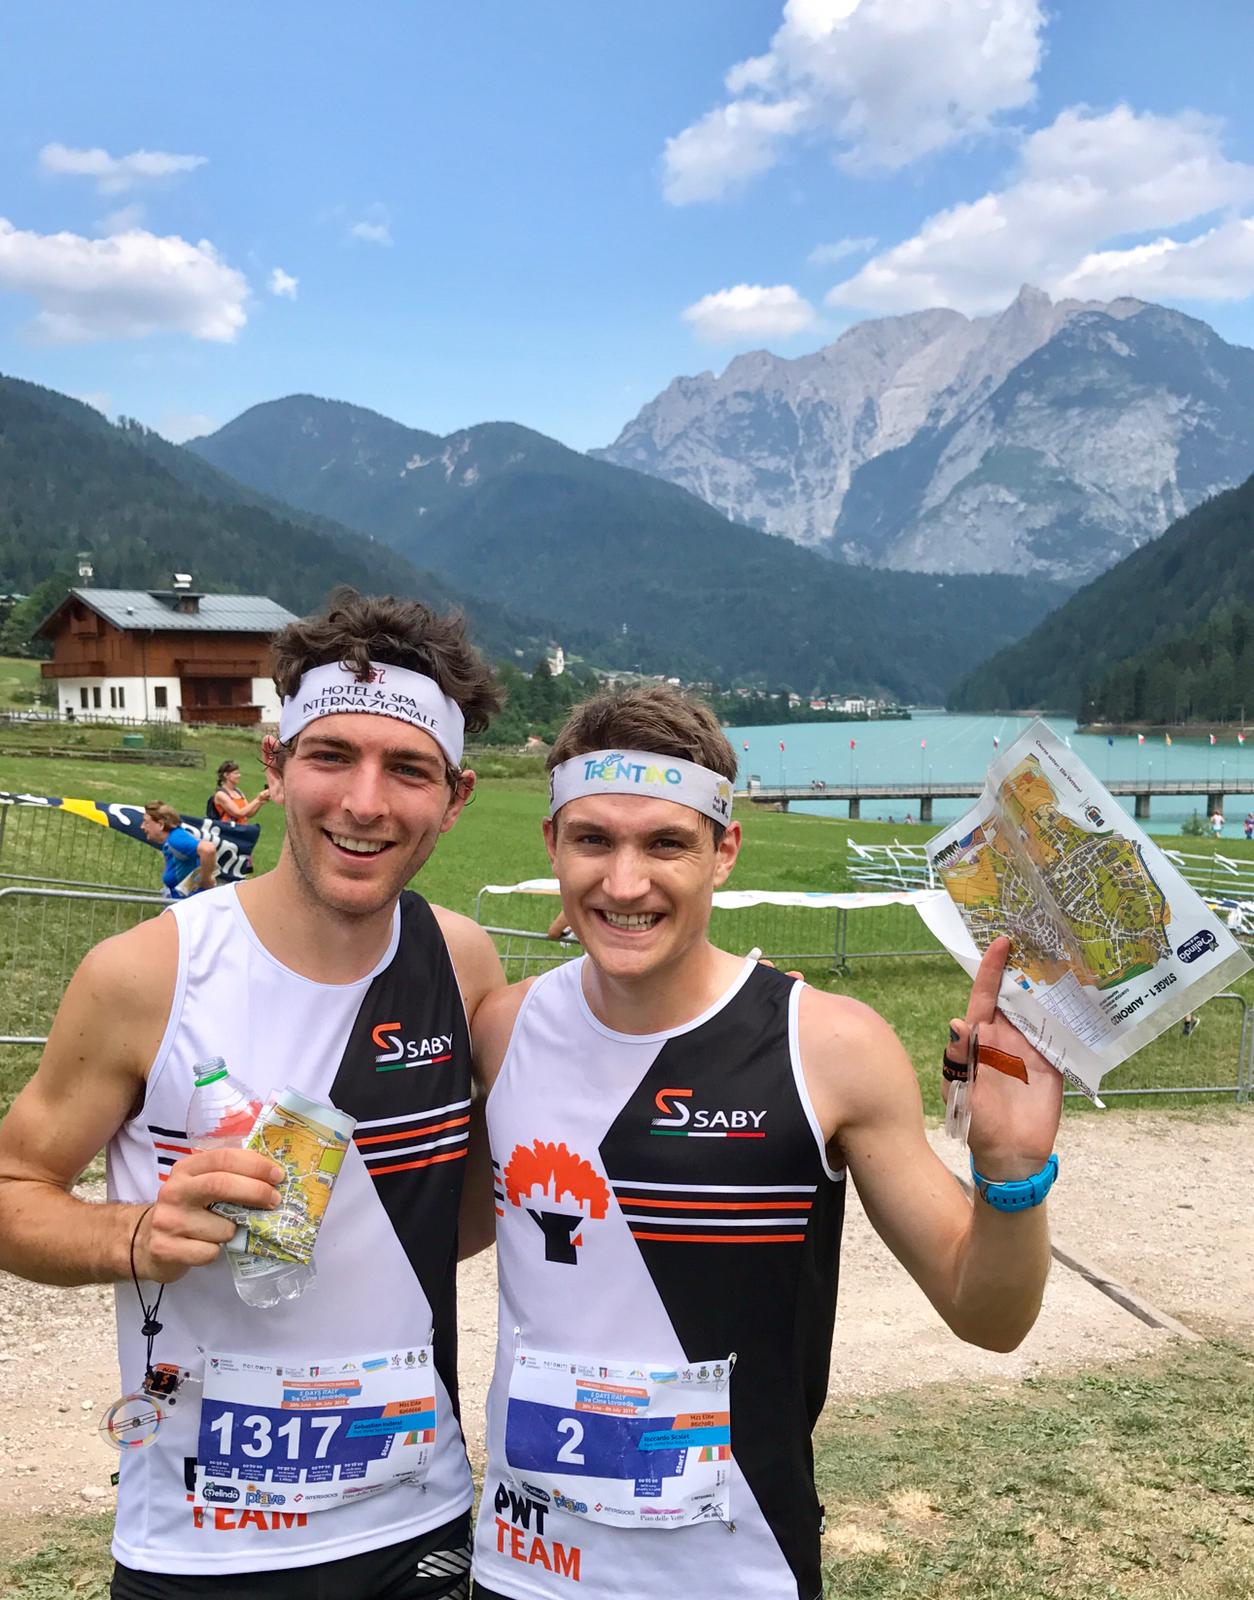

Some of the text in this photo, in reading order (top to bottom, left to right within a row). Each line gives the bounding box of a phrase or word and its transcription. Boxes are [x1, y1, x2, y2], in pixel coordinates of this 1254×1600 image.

[322, 685, 418, 709] HOTEL & SPA
[302, 696, 440, 729] INTERNAZIONALE
[584, 758, 682, 785] TRENTINO
[1179, 933, 1214, 961] Melinda
[1148, 988, 1157, 997] 1
[1153, 972, 1178, 994] STAGE
[406, 1033, 454, 1059] SABY
[693, 1109, 768, 1128] SABY
[210, 1411, 342, 1460] 1317
[556, 1418, 585, 1465] 2
[380, 1440, 392, 1457] Start
[675, 1454, 685, 1474] Start
[203, 1488, 239, 1500] Melinda
[245, 1490, 286, 1507] piave
[494, 1482, 550, 1536] PWT
[495, 1516, 582, 1582] TEAM
